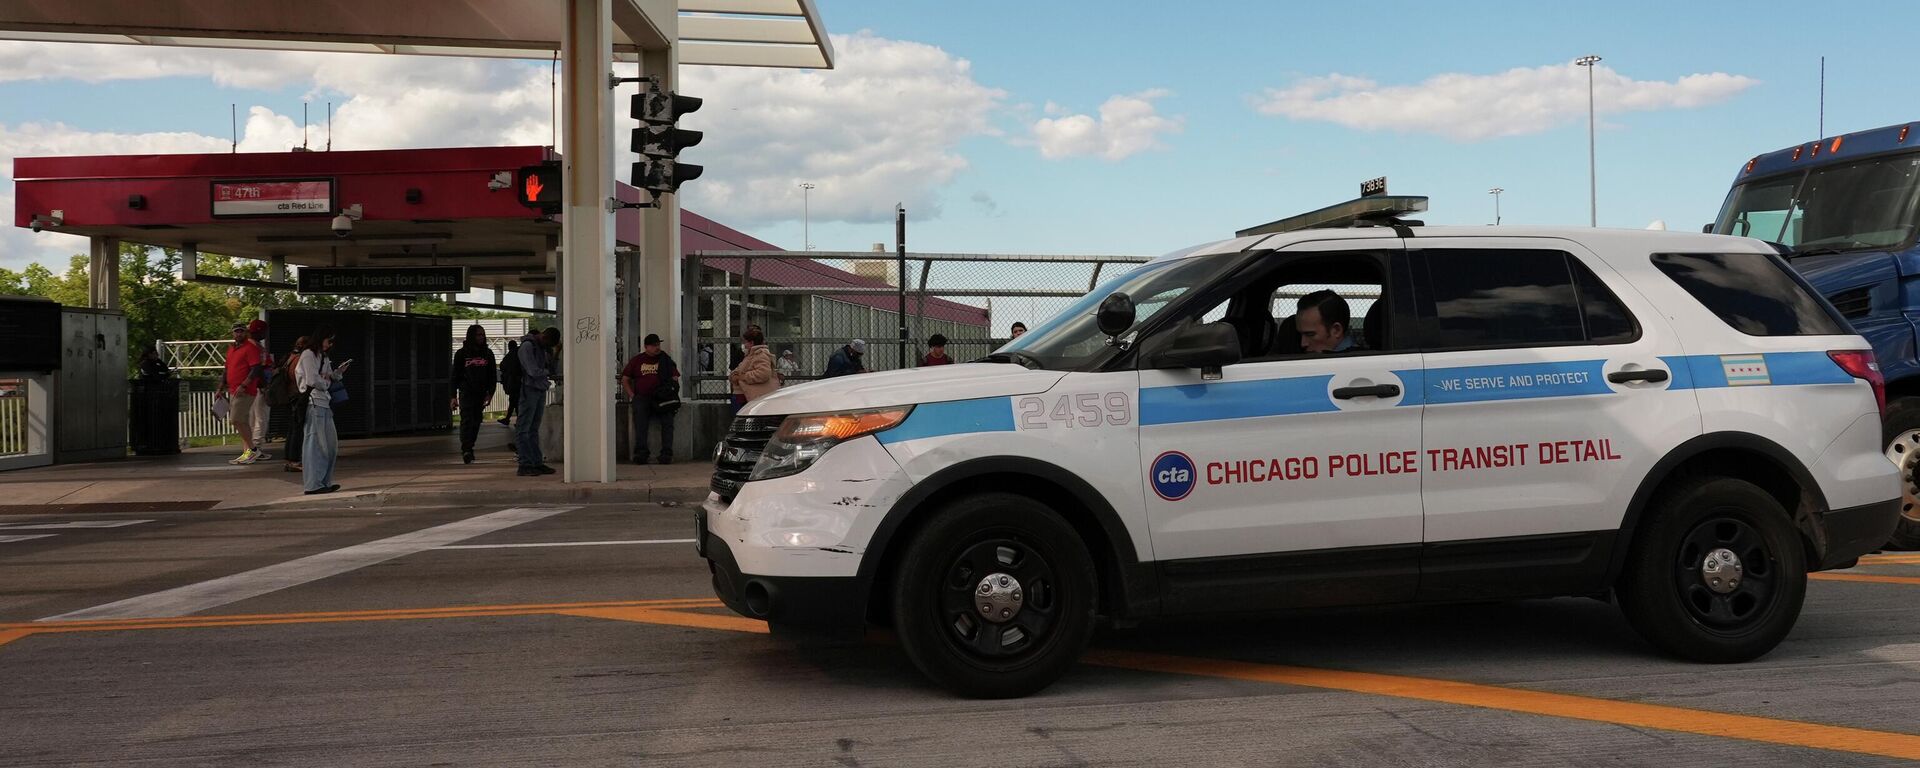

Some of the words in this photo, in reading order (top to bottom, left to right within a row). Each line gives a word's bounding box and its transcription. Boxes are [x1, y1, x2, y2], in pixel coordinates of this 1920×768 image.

[234, 186, 260, 199] 47th
[291, 202, 306, 210] Red
[308, 201, 324, 209] Line
[323, 274, 358, 287] Enter
[362, 274, 393, 286] here
[395, 273, 415, 285] for
[417, 273, 455, 285] trains
[1440, 379, 1462, 391] WE
[1464, 377, 1504, 390] SERVE
[1509, 375, 1533, 388] AND
[1536, 372, 1589, 386] PROTECT
[1019, 391, 1131, 430] 2459
[1206, 456, 1319, 485] CHICAGO
[1328, 451, 1418, 478] POLICE
[1427, 443, 1529, 471] TRANSIT
[1538, 438, 1622, 465] DETAIL
[1158, 466, 1189, 484] cta
